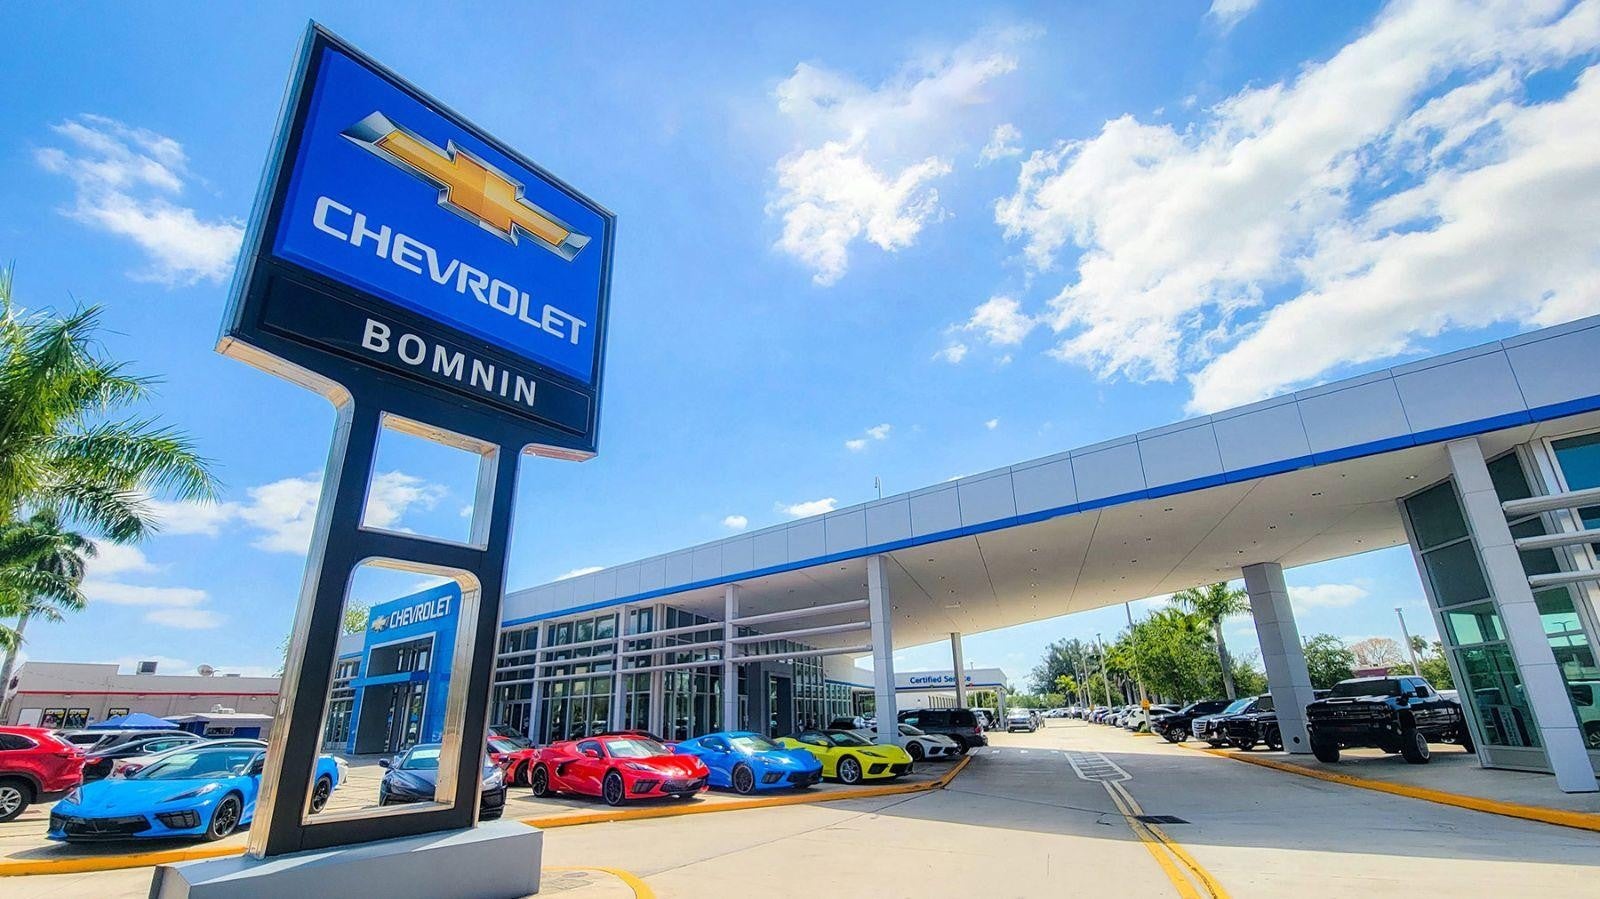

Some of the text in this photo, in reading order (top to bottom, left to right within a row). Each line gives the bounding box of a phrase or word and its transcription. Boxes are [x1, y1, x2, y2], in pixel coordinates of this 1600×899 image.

[313, 196, 587, 345] CHEVROLET
[361, 318, 537, 407] BOMNIN
[389, 595, 452, 628] CHEVROLET
[910, 676, 942, 684] Certified
